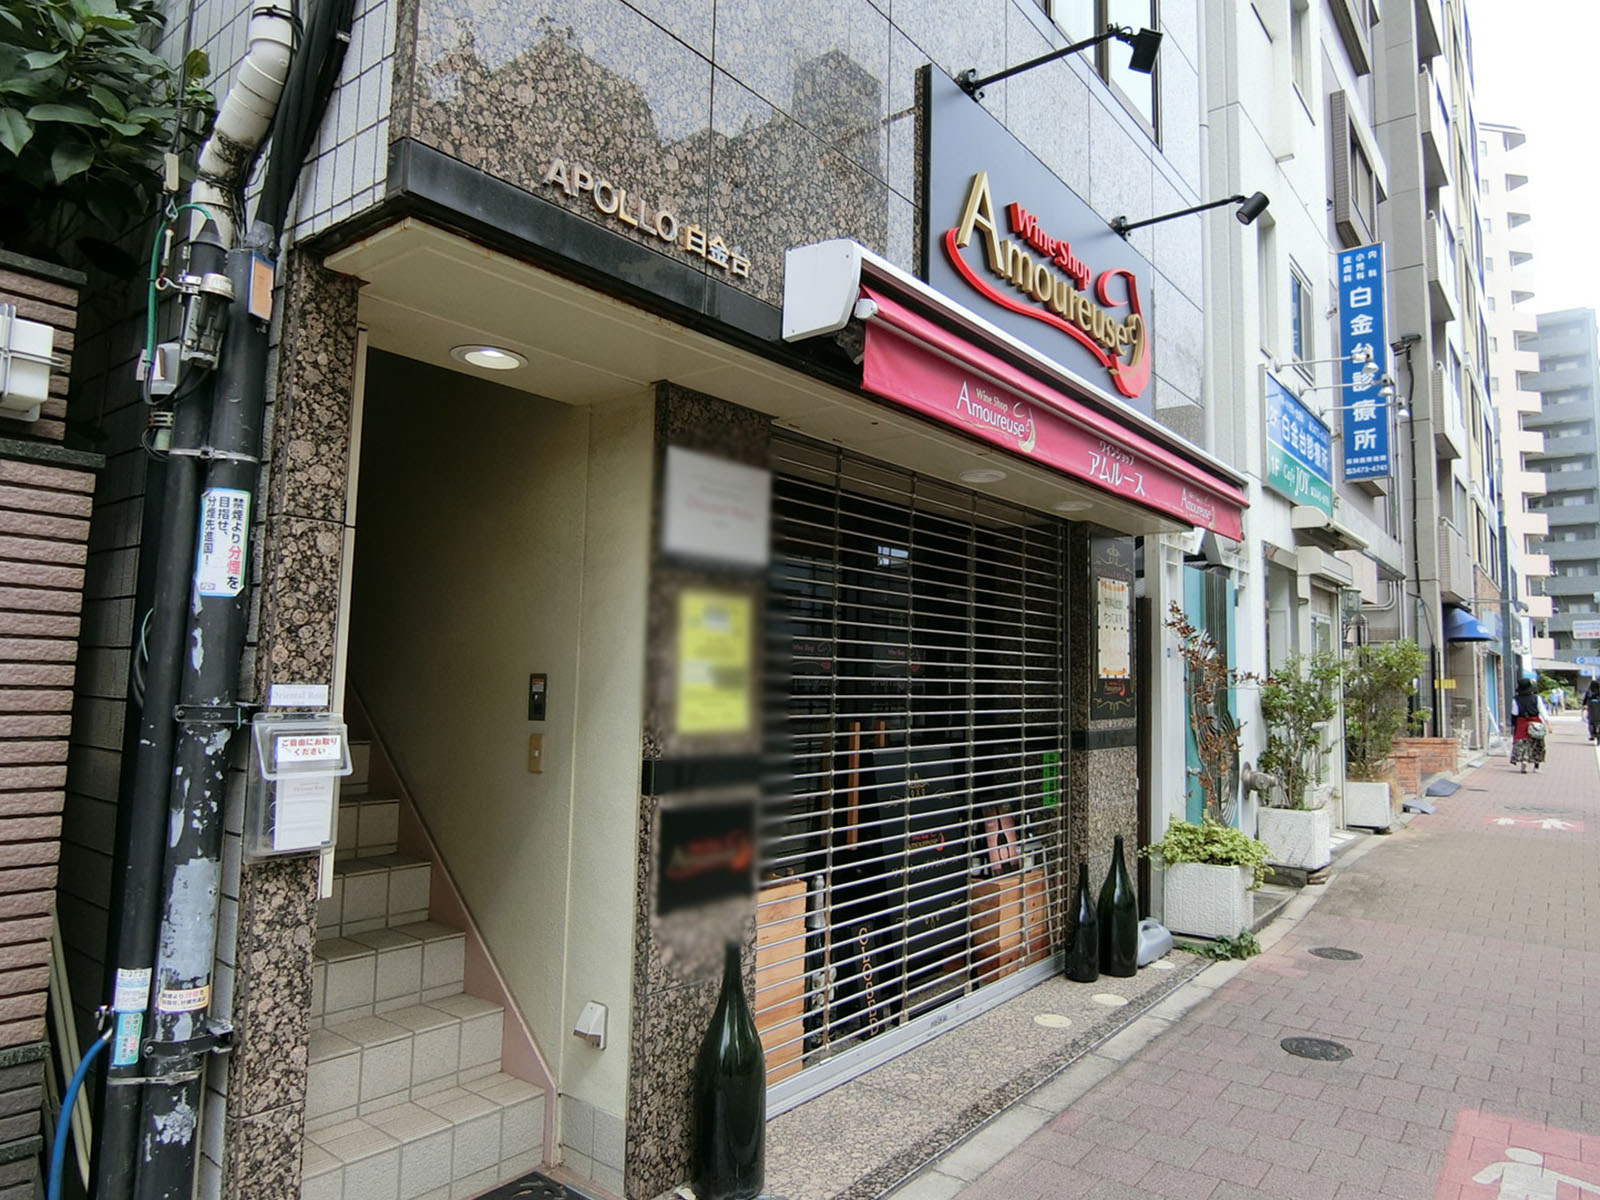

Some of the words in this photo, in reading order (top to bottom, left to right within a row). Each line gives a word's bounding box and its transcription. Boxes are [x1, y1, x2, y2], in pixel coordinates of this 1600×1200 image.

[543, 157, 678, 241] APOLLO
[684, 224, 751, 279] 白金台
[1006, 202, 1057, 257] Wine
[1055, 240, 1092, 291] Shop
[957, 170, 1130, 356] Amoureuse
[975, 387, 993, 405] Wine
[993, 395, 1009, 414] Shop
[1350, 286, 1376, 451] 白金台診療所
[956, 380, 1025, 438] Amoureuse
[1088, 450, 1146, 497] アムルース
[227, 497, 245, 590] 禁煙より分煙を
[281, 737, 337, 748] ご自由にお取り
[294, 746, 326, 756] ください
